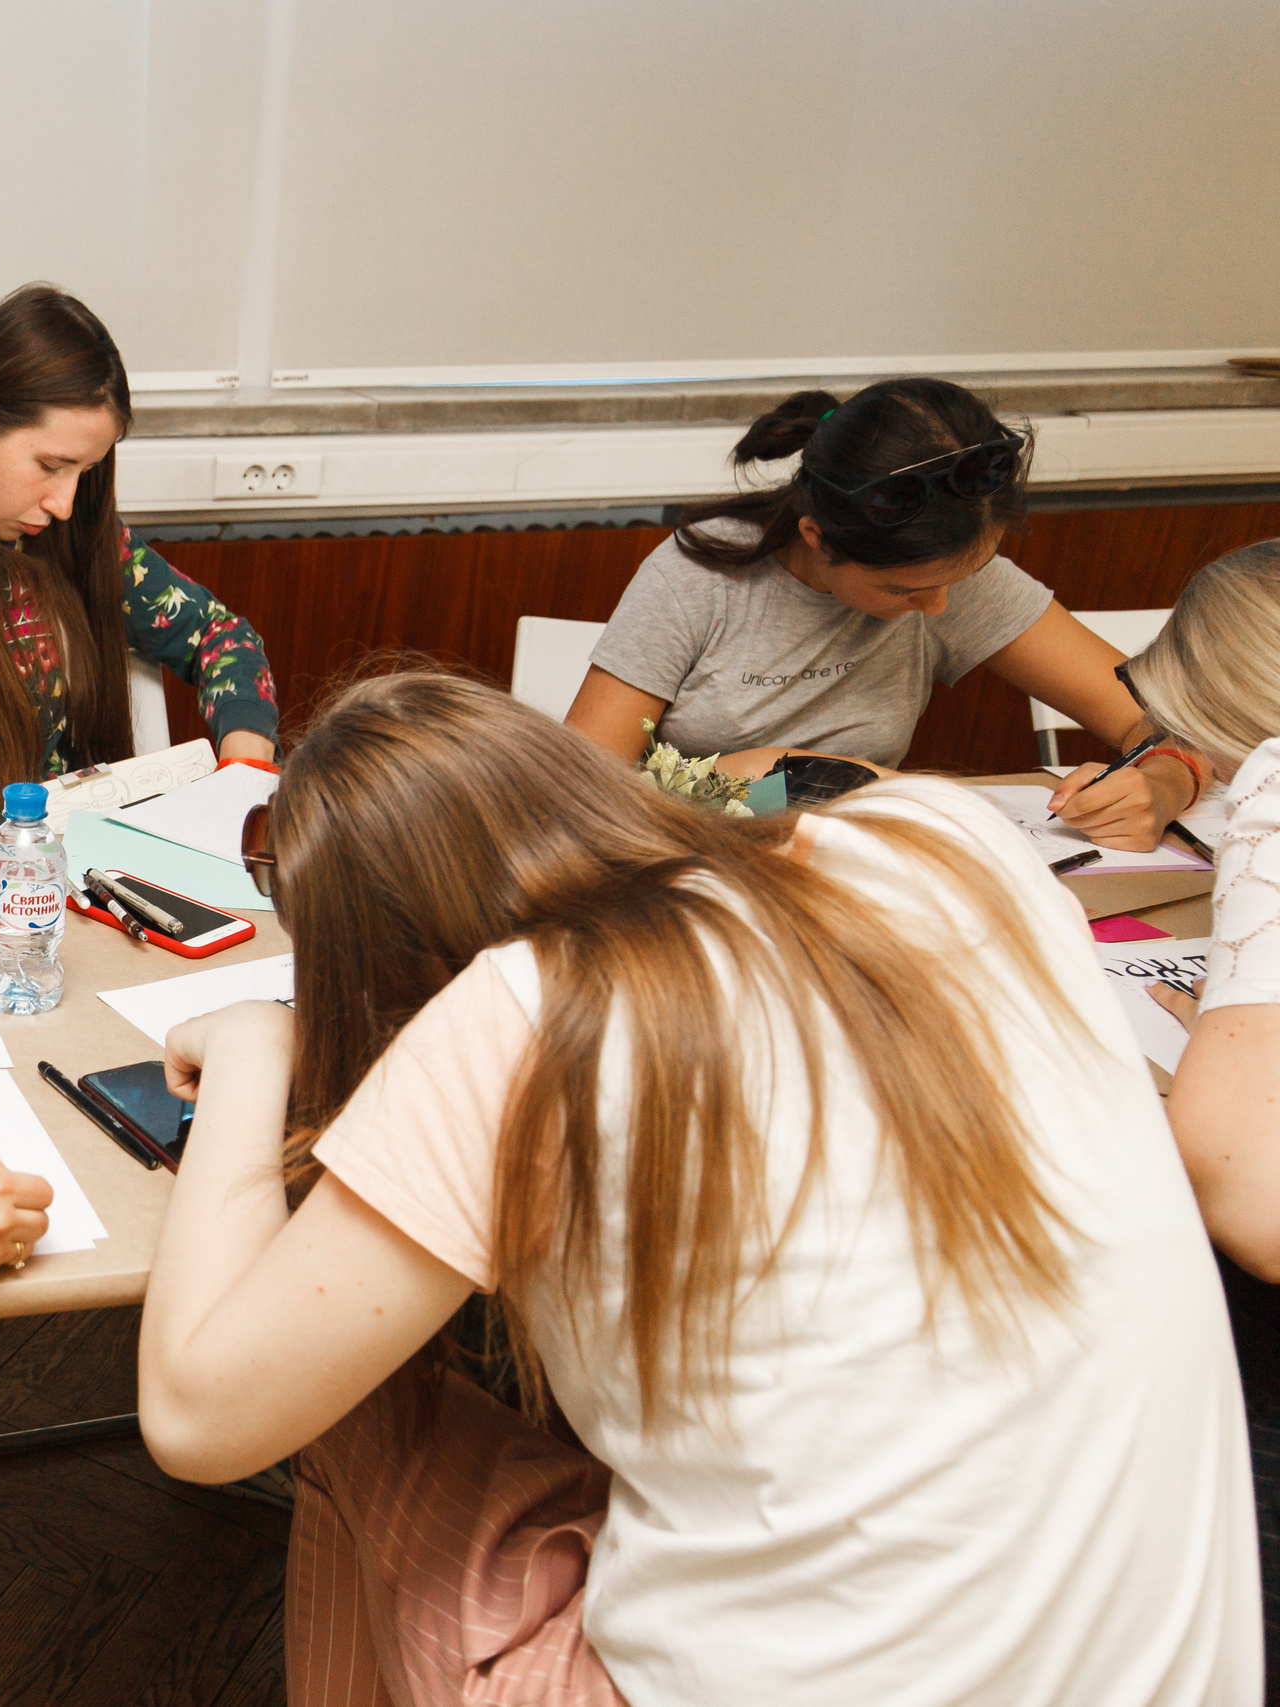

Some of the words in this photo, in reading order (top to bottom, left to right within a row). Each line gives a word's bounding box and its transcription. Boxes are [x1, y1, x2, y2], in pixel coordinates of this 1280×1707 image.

[741, 671, 799, 687] Unicor
[801, 667, 831, 680] are
[2, 902, 61, 917] Источник
